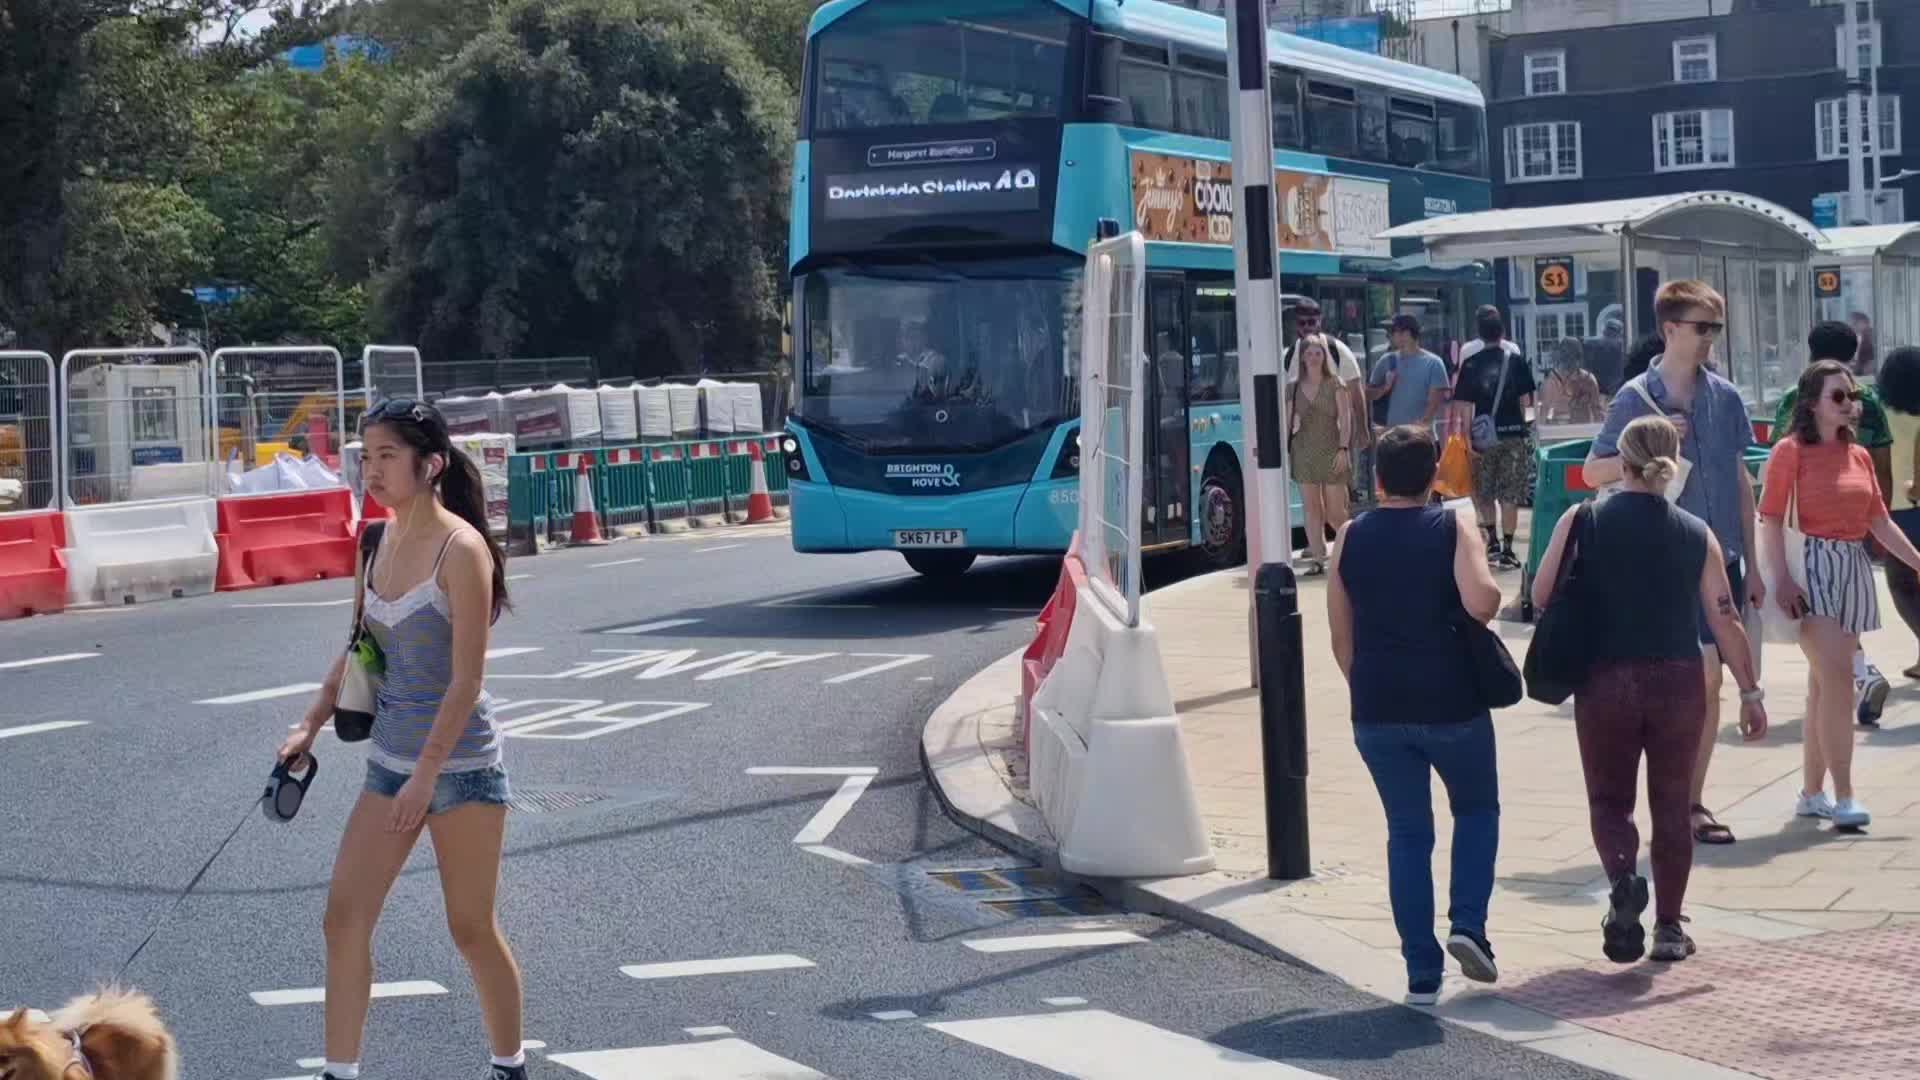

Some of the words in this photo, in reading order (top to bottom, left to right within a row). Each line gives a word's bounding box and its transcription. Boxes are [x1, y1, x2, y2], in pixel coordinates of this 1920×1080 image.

[1544, 271, 1565, 288] S1
[886, 463, 941, 474] BRIGHTON
[911, 477, 941, 488] HOVE
[899, 531, 931, 545] SK67
[933, 531, 959, 544] FLP
